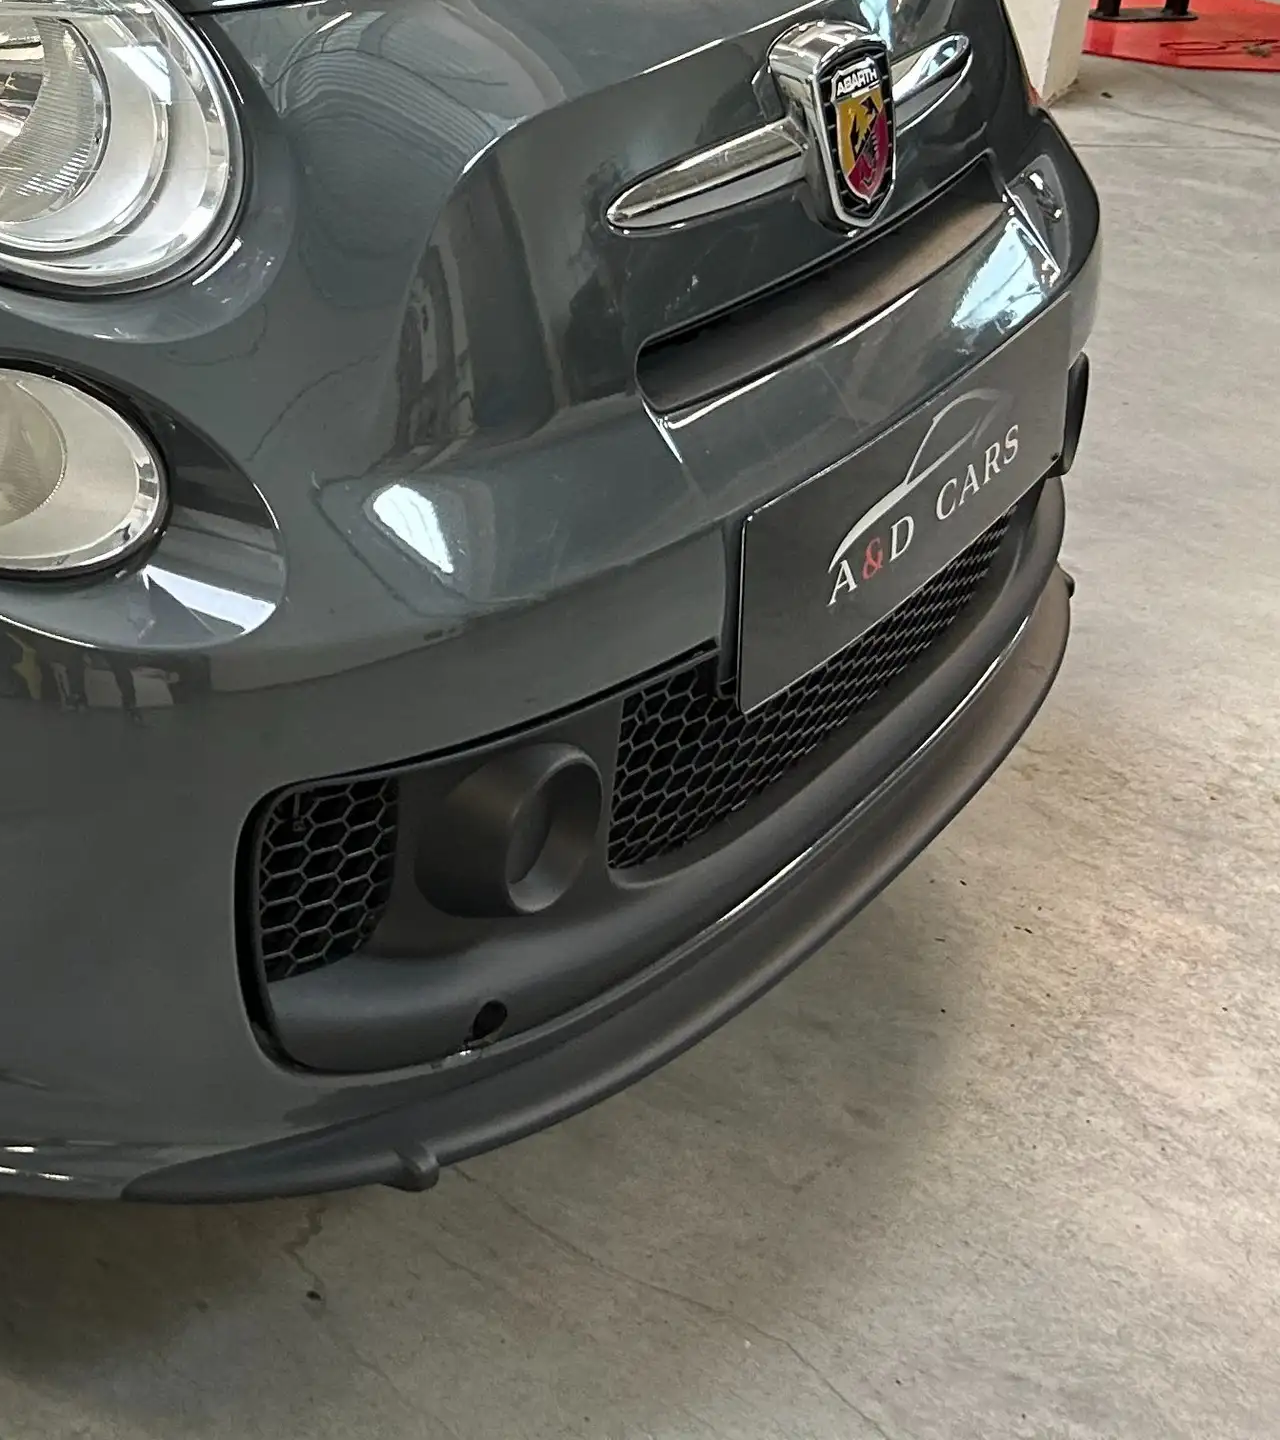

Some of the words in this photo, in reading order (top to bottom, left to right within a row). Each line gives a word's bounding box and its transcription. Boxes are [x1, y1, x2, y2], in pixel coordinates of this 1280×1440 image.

[836, 68, 878, 96] ABARTH
[827, 515, 915, 607] A&D
[934, 424, 1019, 521] CARS
